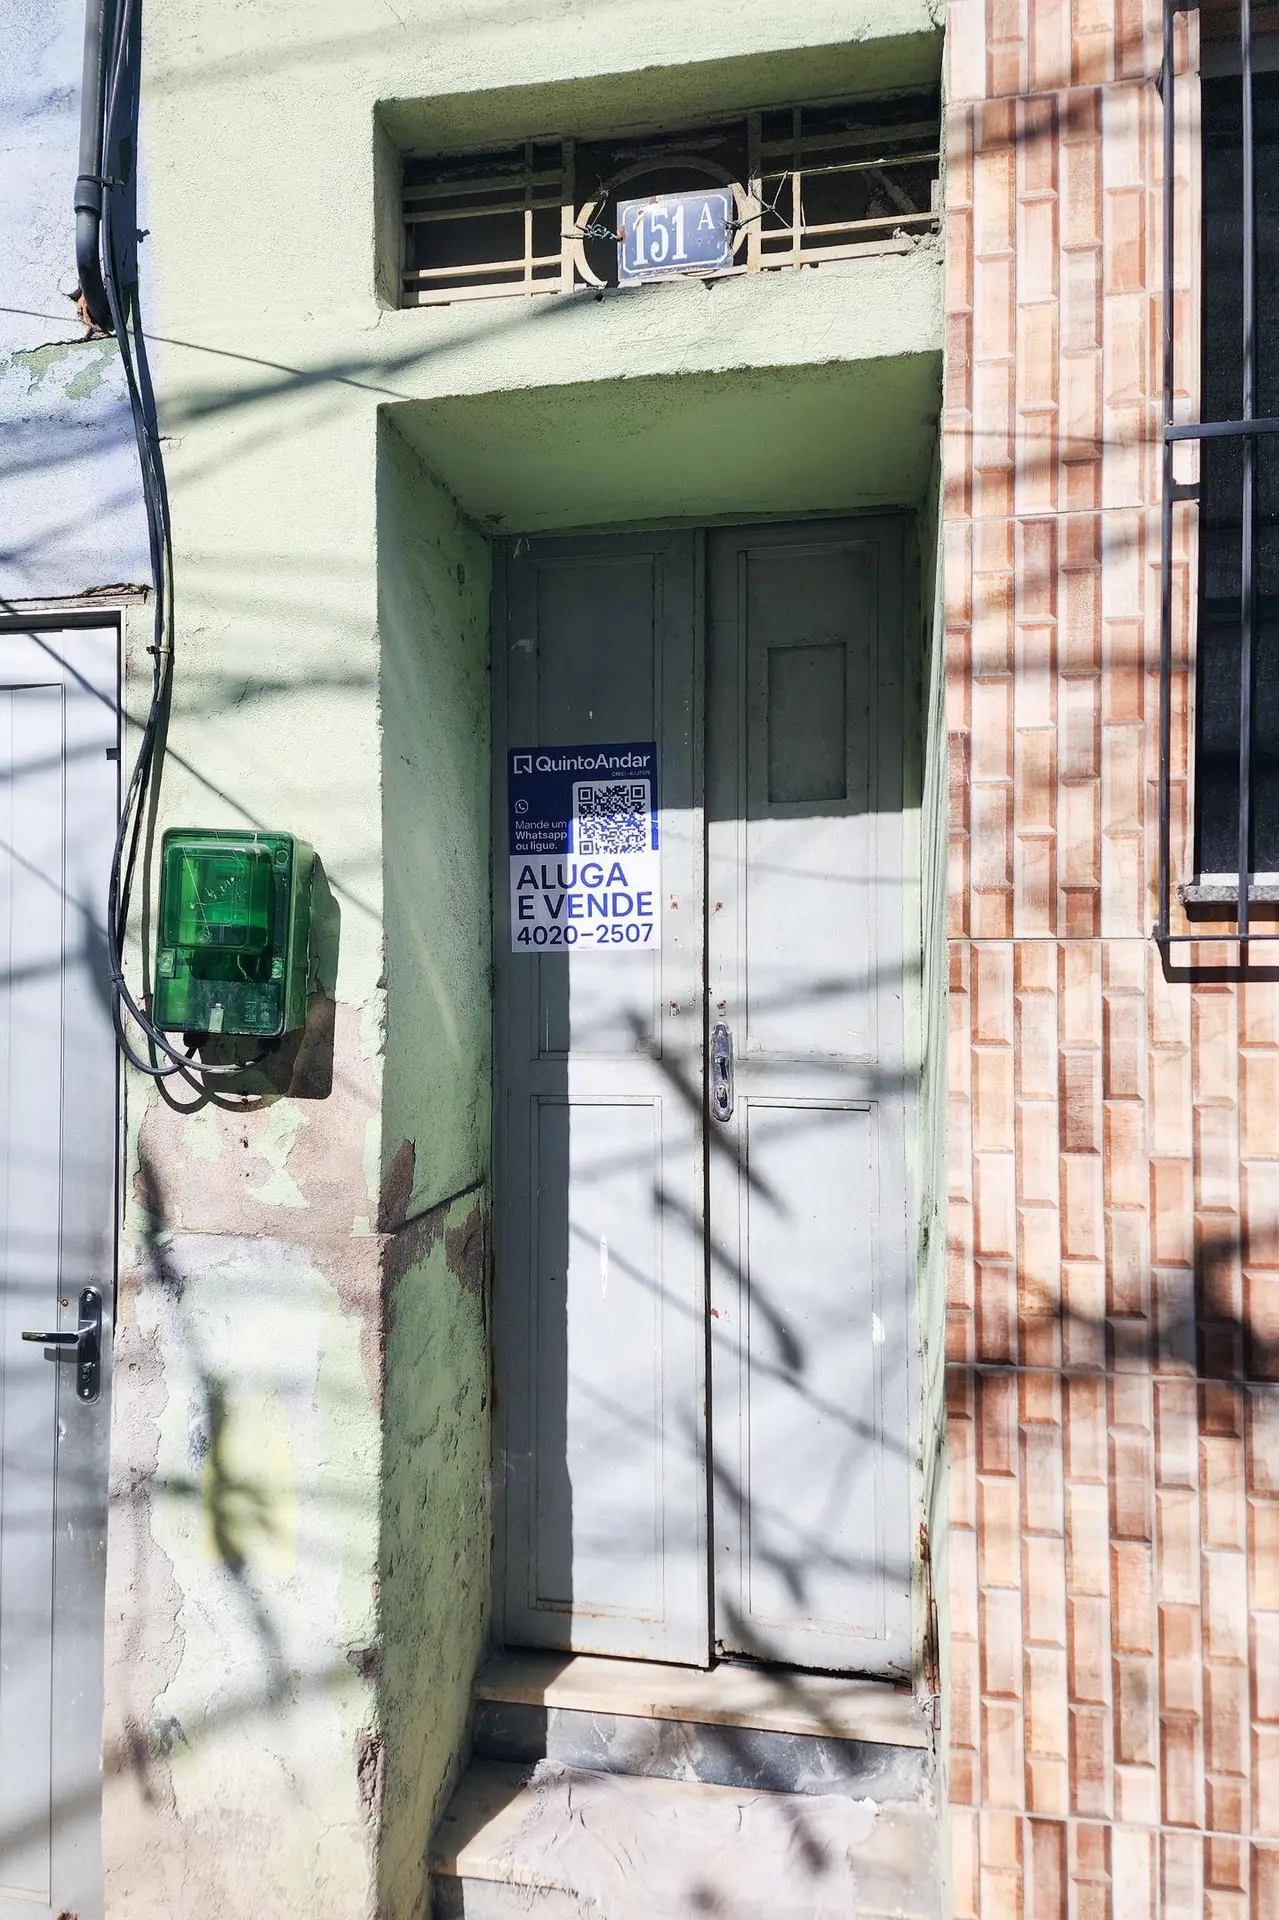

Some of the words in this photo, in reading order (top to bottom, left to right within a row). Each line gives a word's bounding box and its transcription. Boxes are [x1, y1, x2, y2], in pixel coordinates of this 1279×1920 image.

[632, 204, 688, 266] 151
[697, 202, 716, 230] A
[536, 752, 651, 772] QuintoAndar
[515, 820, 550, 830] Mande
[552, 820, 567, 829] um
[515, 830, 568, 841] Whatsapp
[516, 843, 529, 851] ou
[530, 840, 558, 853] ligue.
[516, 862, 629, 891] ALUGA
[518, 895, 535, 920] E
[544, 891, 653, 919] VENDE
[517, 923, 653, 945] 4020-2507
